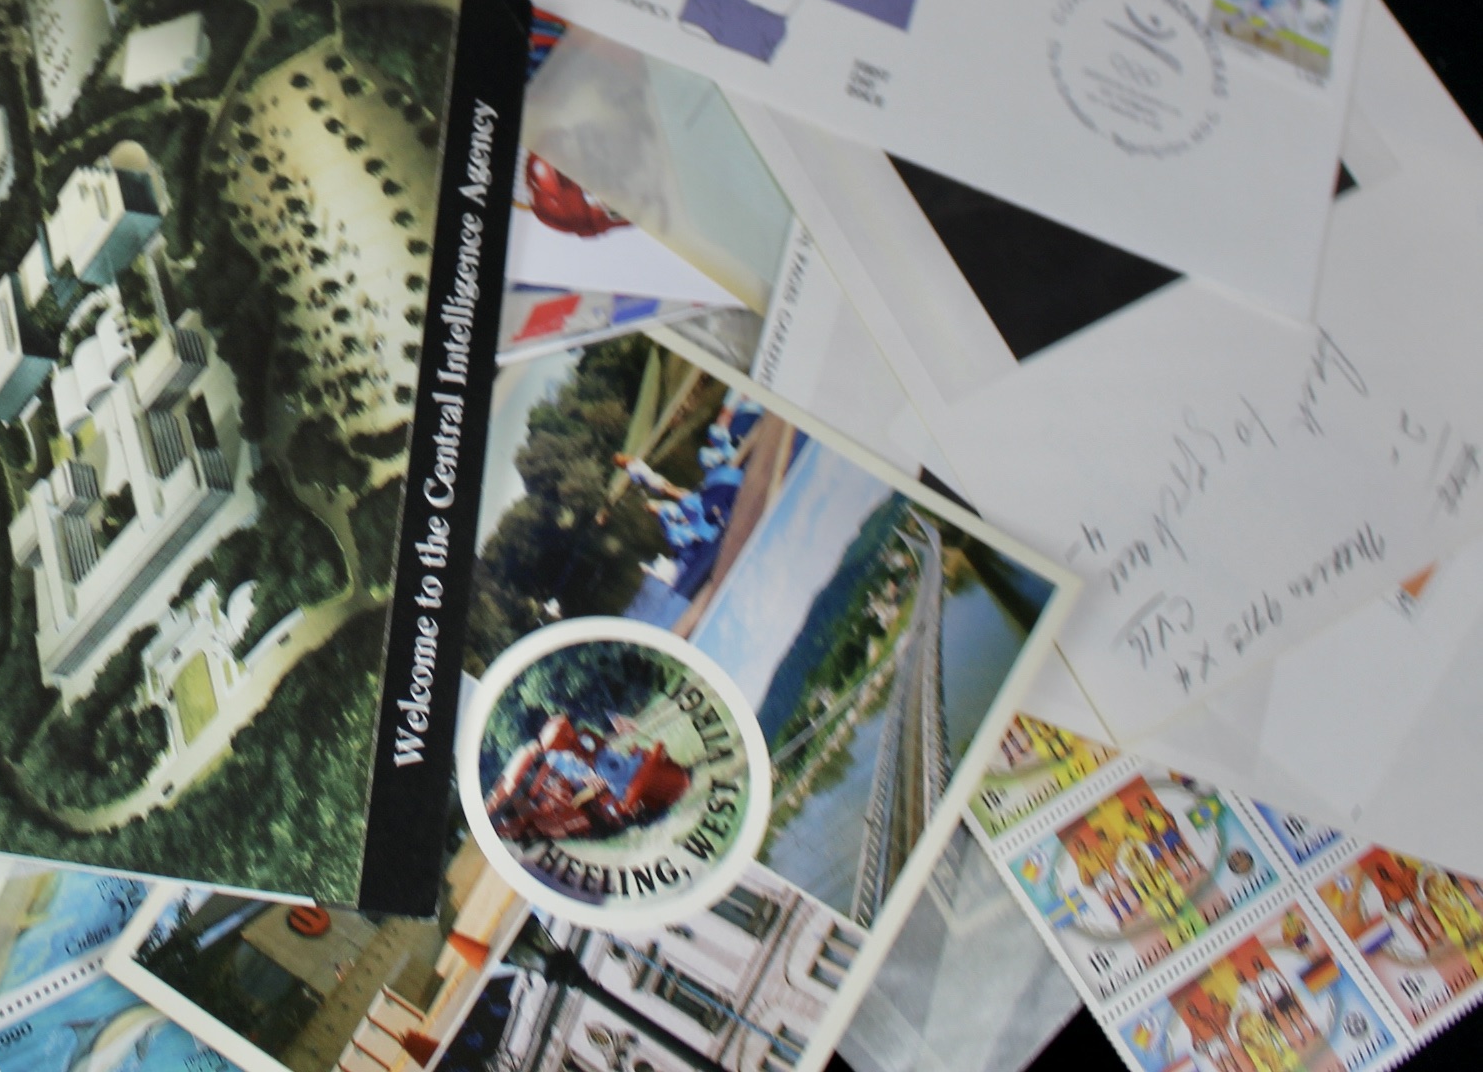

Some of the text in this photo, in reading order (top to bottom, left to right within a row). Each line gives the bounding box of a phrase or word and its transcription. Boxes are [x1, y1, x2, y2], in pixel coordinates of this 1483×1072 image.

[393, 97, 500, 769] Welcome to the Central Intelligence Agency
[527, 836, 693, 896] HEELING,
[682, 776, 741, 862] WEST
